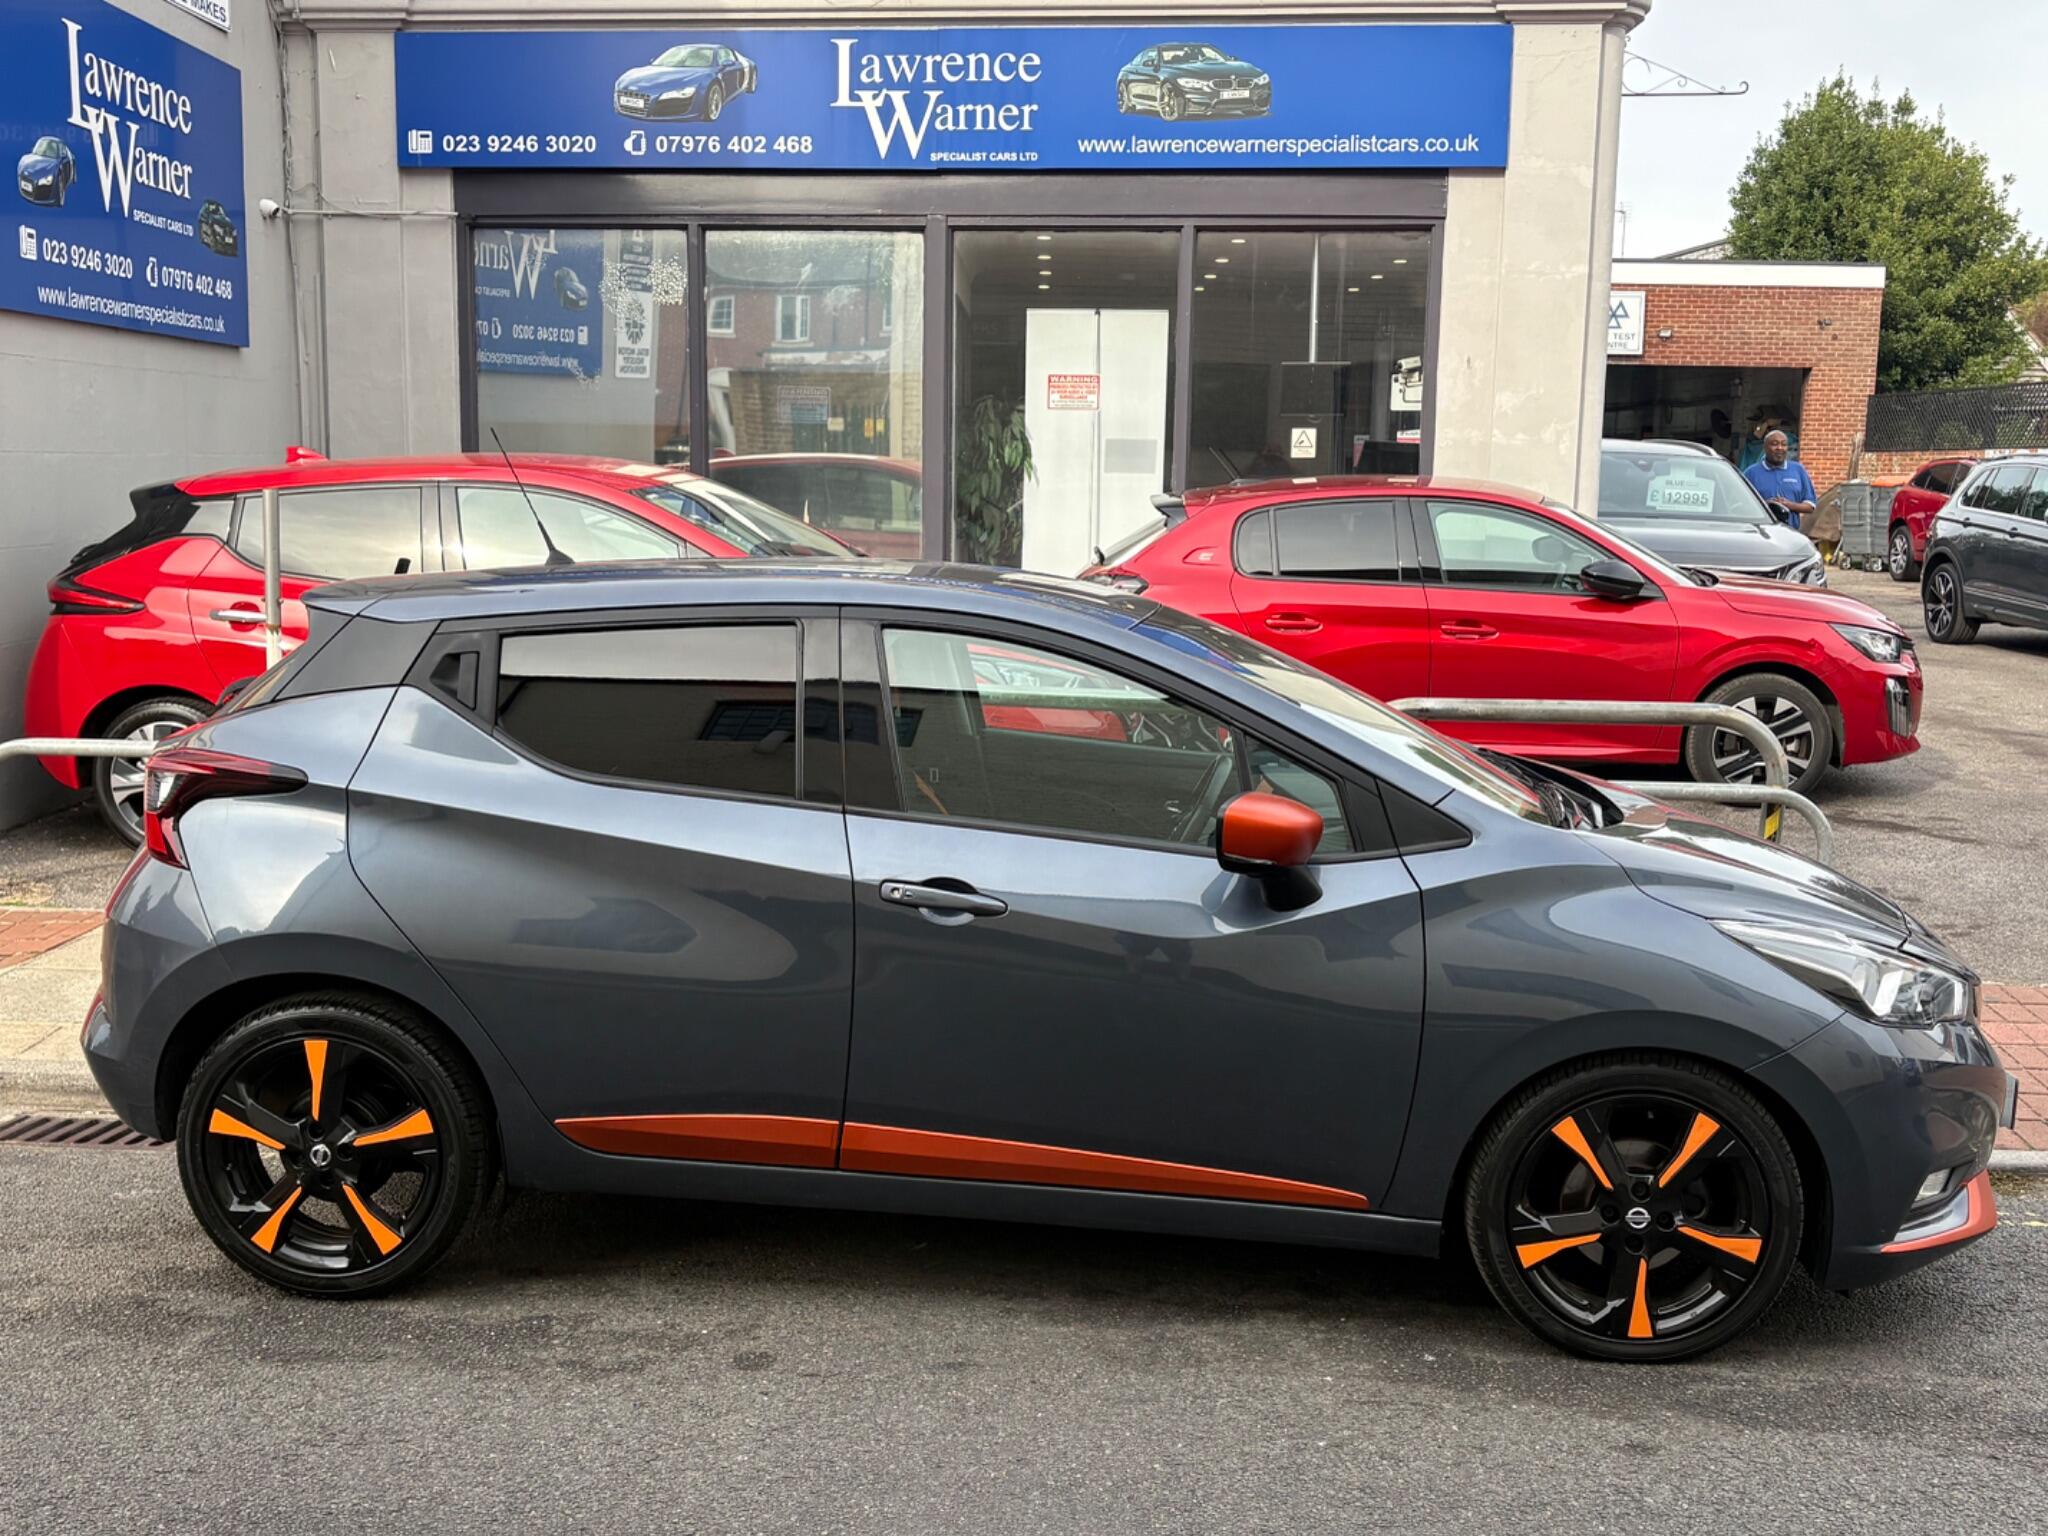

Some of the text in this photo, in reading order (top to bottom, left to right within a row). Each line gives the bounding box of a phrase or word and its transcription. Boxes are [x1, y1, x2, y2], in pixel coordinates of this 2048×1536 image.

[61, 17, 193, 135] Lawrence
[830, 38, 1042, 107] Lawrence
[854, 88, 1039, 160] Warner
[442, 135, 597, 153] 023 9246 3020
[655, 135, 813, 153] 07976 402 468
[930, 151, 1039, 161] SPECIALIST CARS LTD
[1077, 134, 1479, 156] www.lawrencewarnerspecialistcars.co.uk
[83, 104, 193, 218] Warner
[133, 209, 194, 237] SPECIALIST CARS LTD
[42, 238, 133, 279] 023 9246 3020
[162, 266, 232, 300] 07976 402 468
[37, 285, 226, 334] www.lawrencewarnerspecialistcars.co.uk
[1608, 341, 1629, 350] NTRE
[1613, 332, 1636, 341] TEST
[1050, 375, 1098, 384] WARNING
[1666, 490, 1709, 506] 12995
